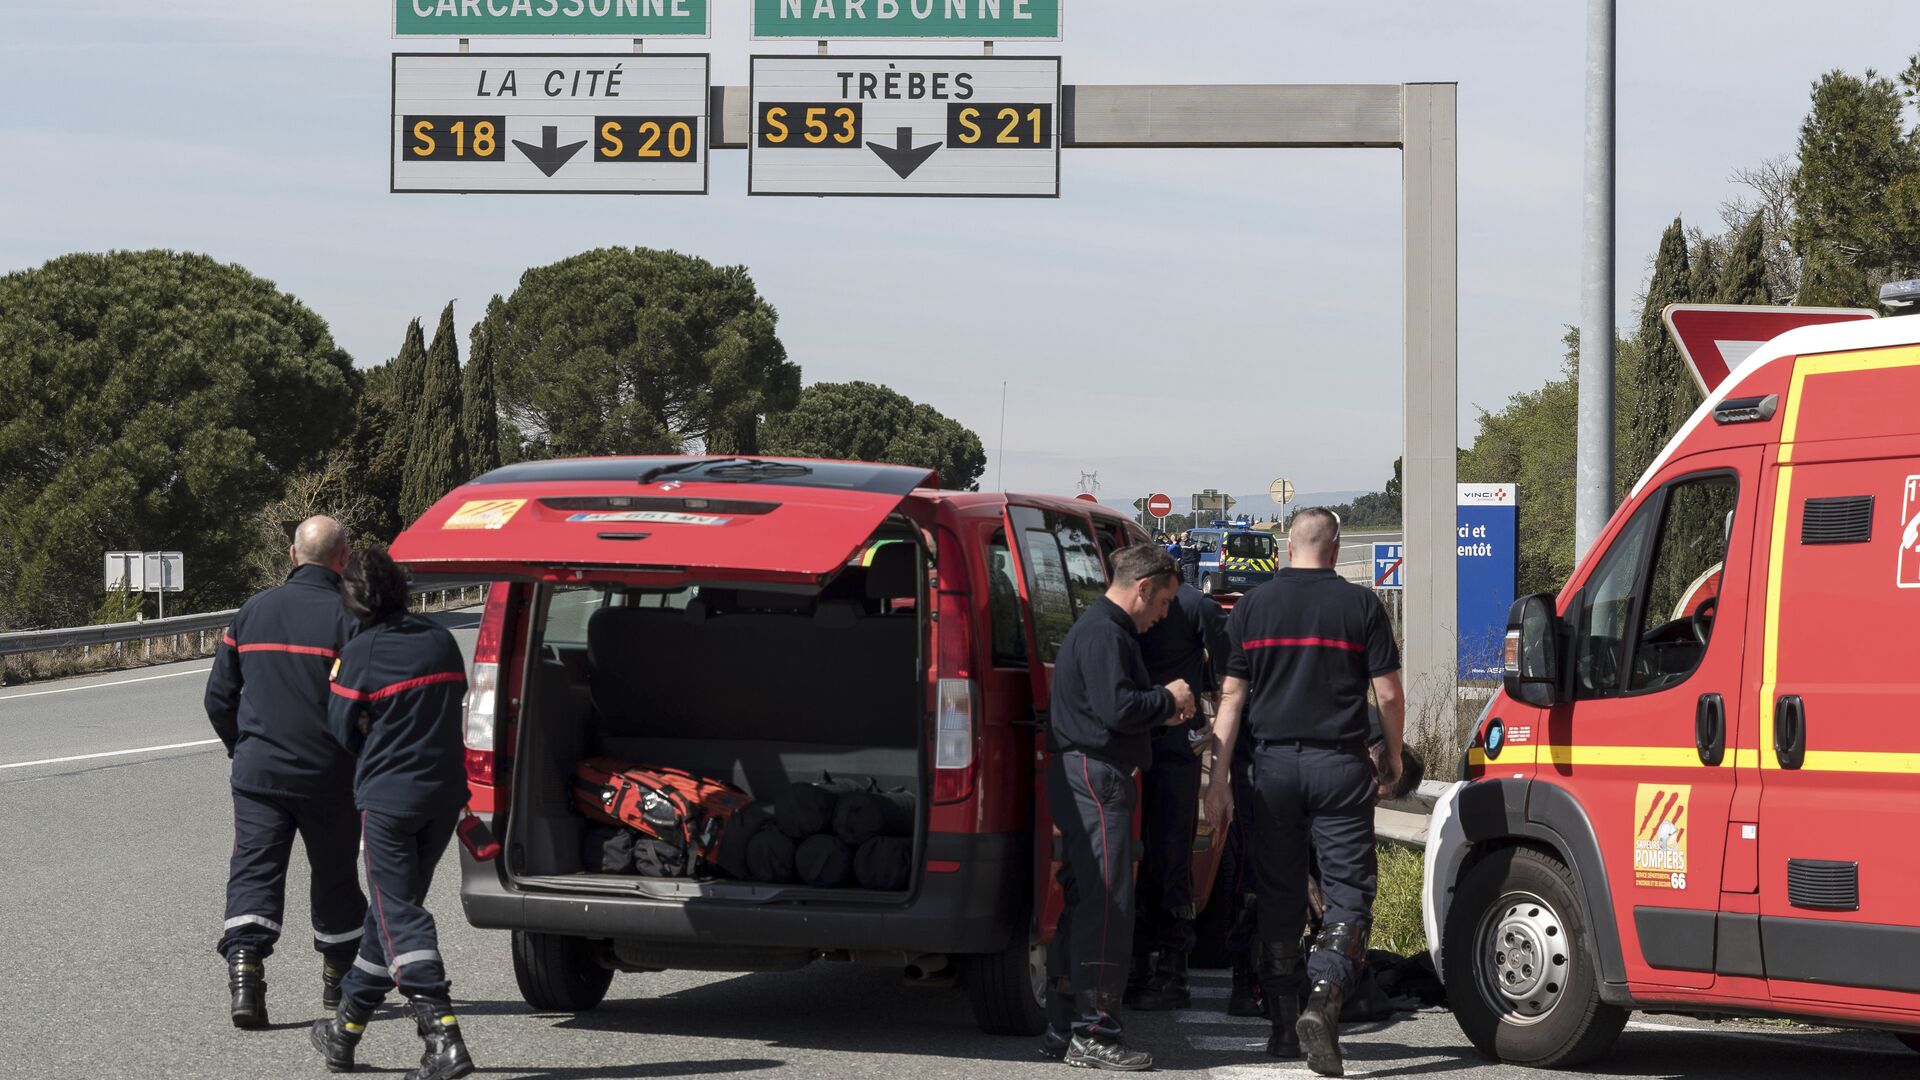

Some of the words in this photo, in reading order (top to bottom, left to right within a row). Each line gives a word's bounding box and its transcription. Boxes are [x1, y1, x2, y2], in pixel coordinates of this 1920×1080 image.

[477, 70, 517, 97] LA
[544, 63, 623, 97] CITÉ
[837, 63, 974, 100] TRÈBES
[413, 120, 435, 157] S
[450, 121, 495, 156] 18
[601, 121, 623, 157] S
[638, 121, 691, 157] 20
[766, 107, 789, 143] S
[803, 107, 855, 144] 53
[958, 108, 981, 144] S
[996, 108, 1041, 144] 21
[1472, 524, 1486, 538] et
[1635, 850, 1685, 869] POMPIERS
[1671, 872, 1686, 890] 66
